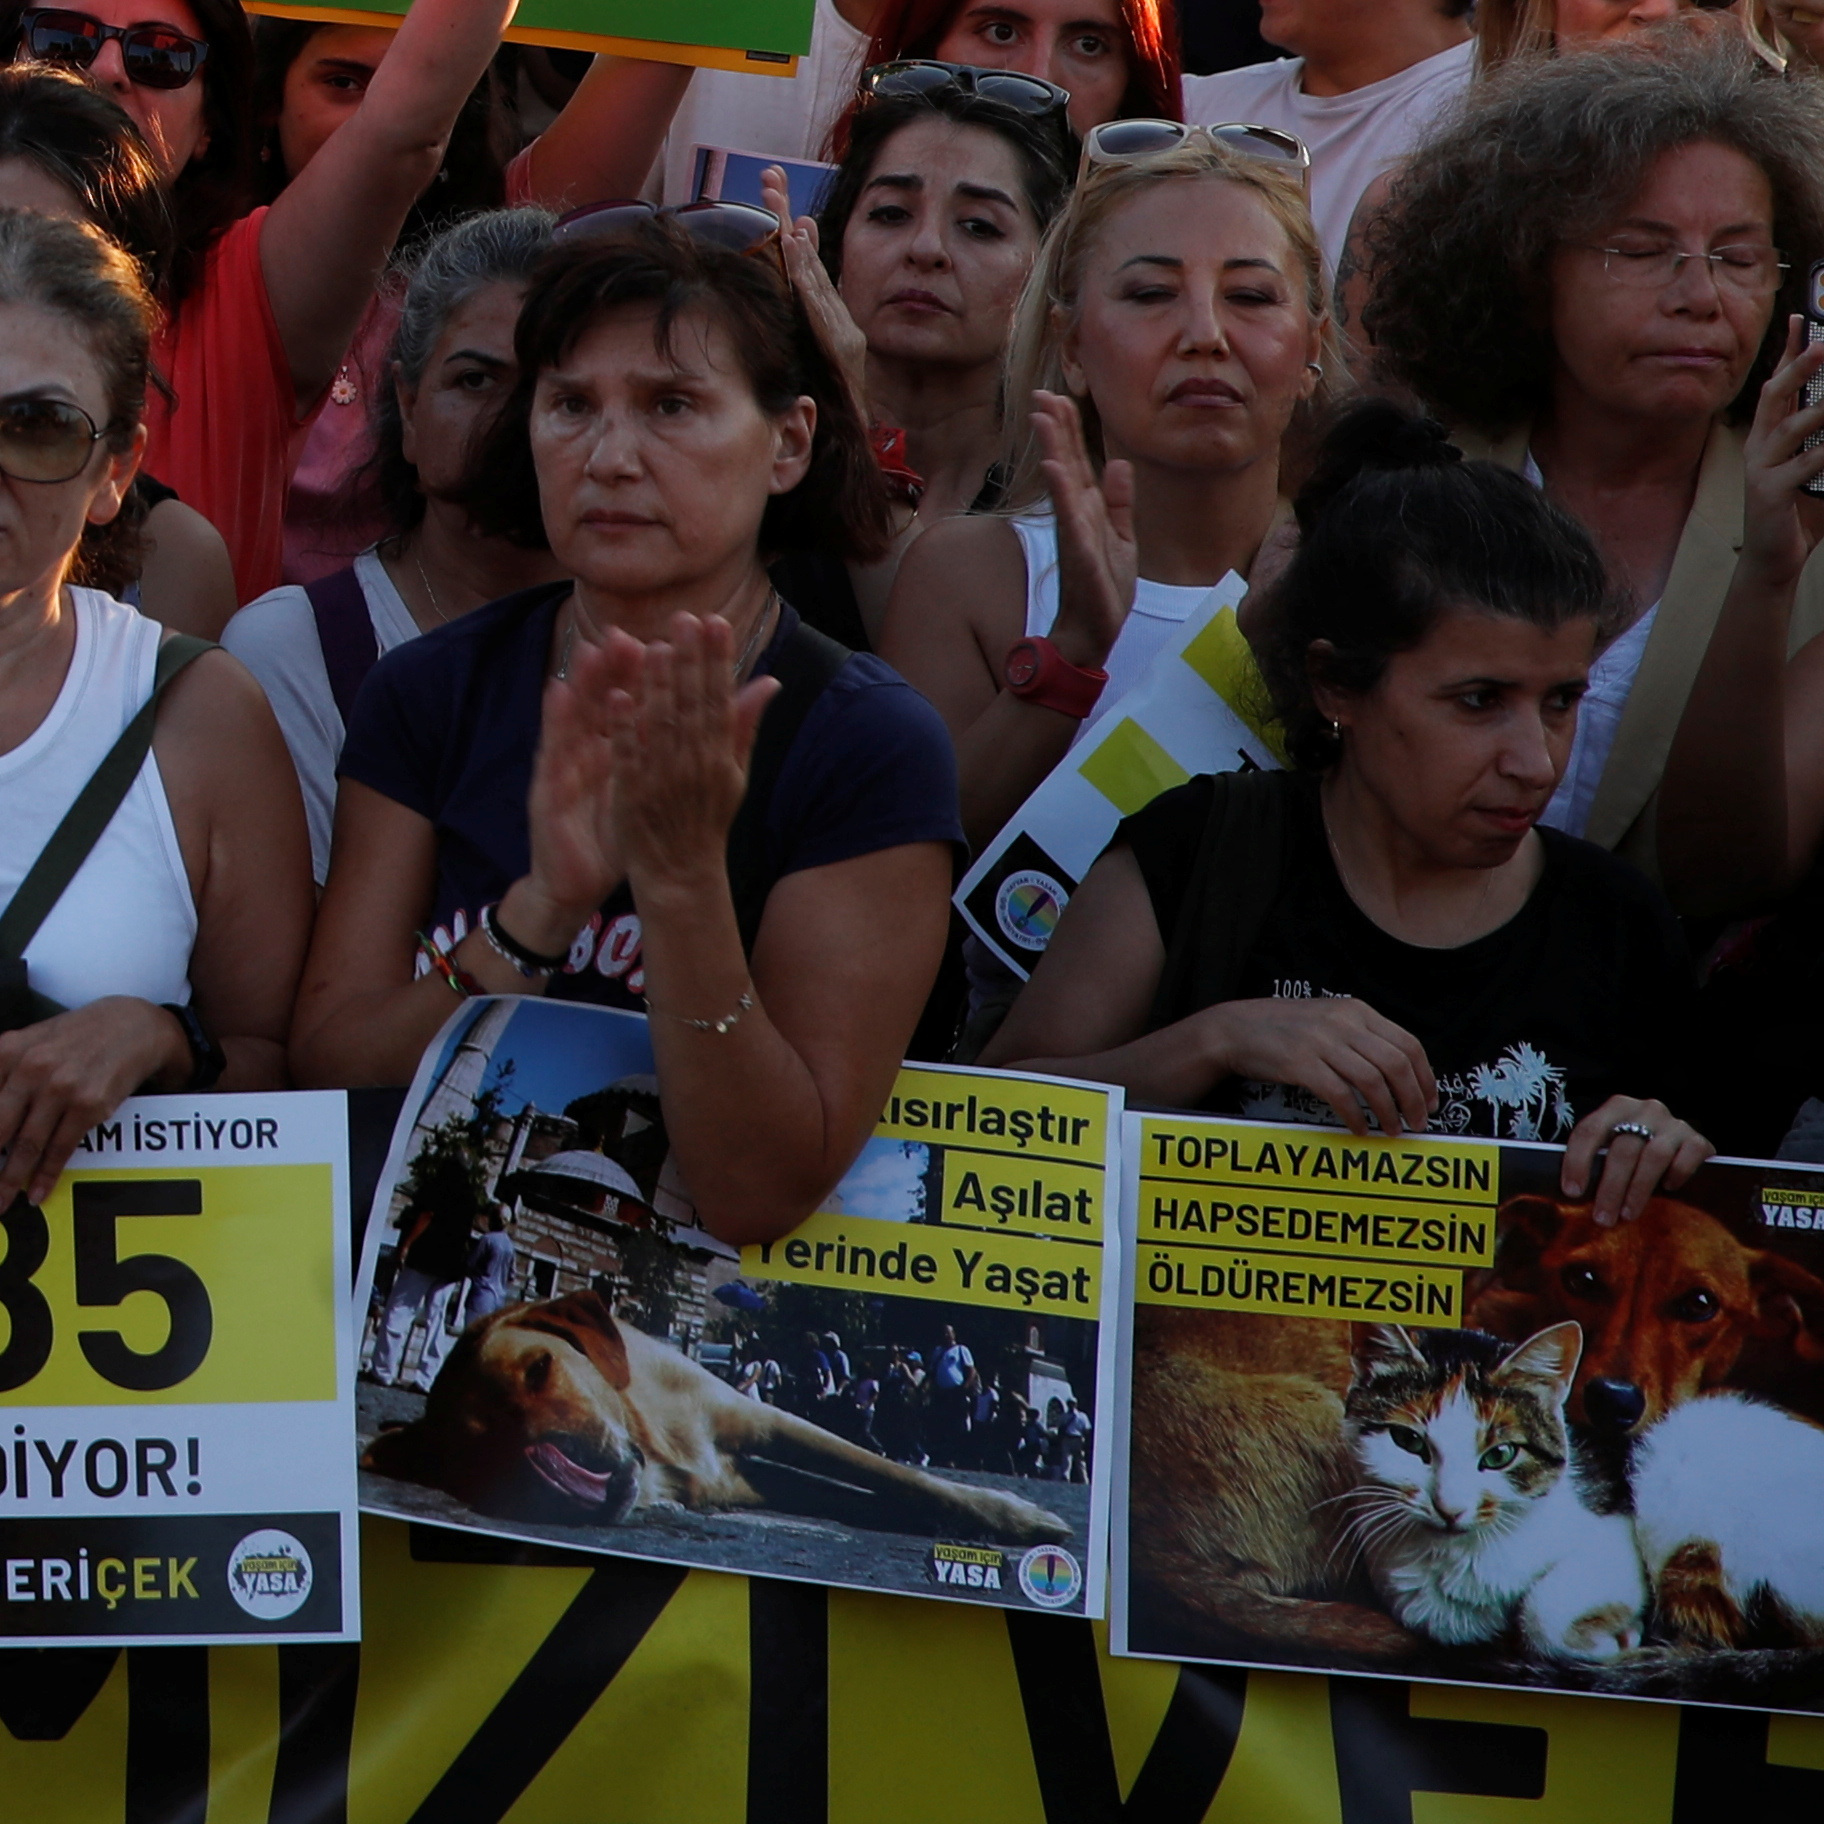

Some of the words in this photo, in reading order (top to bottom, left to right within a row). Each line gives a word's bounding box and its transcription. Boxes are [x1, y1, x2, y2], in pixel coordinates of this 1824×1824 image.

[131, 1114, 281, 1155] İSTİYOR
[1151, 1132, 1494, 1194] TOPLAYAMAZSIN
[952, 1171, 1093, 1234] Aşılat
[1153, 1192, 1488, 1256] HAPSEDEMEZSİN
[952, 1247, 1093, 1308] Yaşat
[1147, 1250, 1457, 1321] ÖLDÜREMEZSİN
[242, 1573, 298, 1596] YASA
[933, 1560, 1003, 1589] YASA
[935, 1545, 976, 1565] yaşam
[978, 1550, 1002, 1565] için
